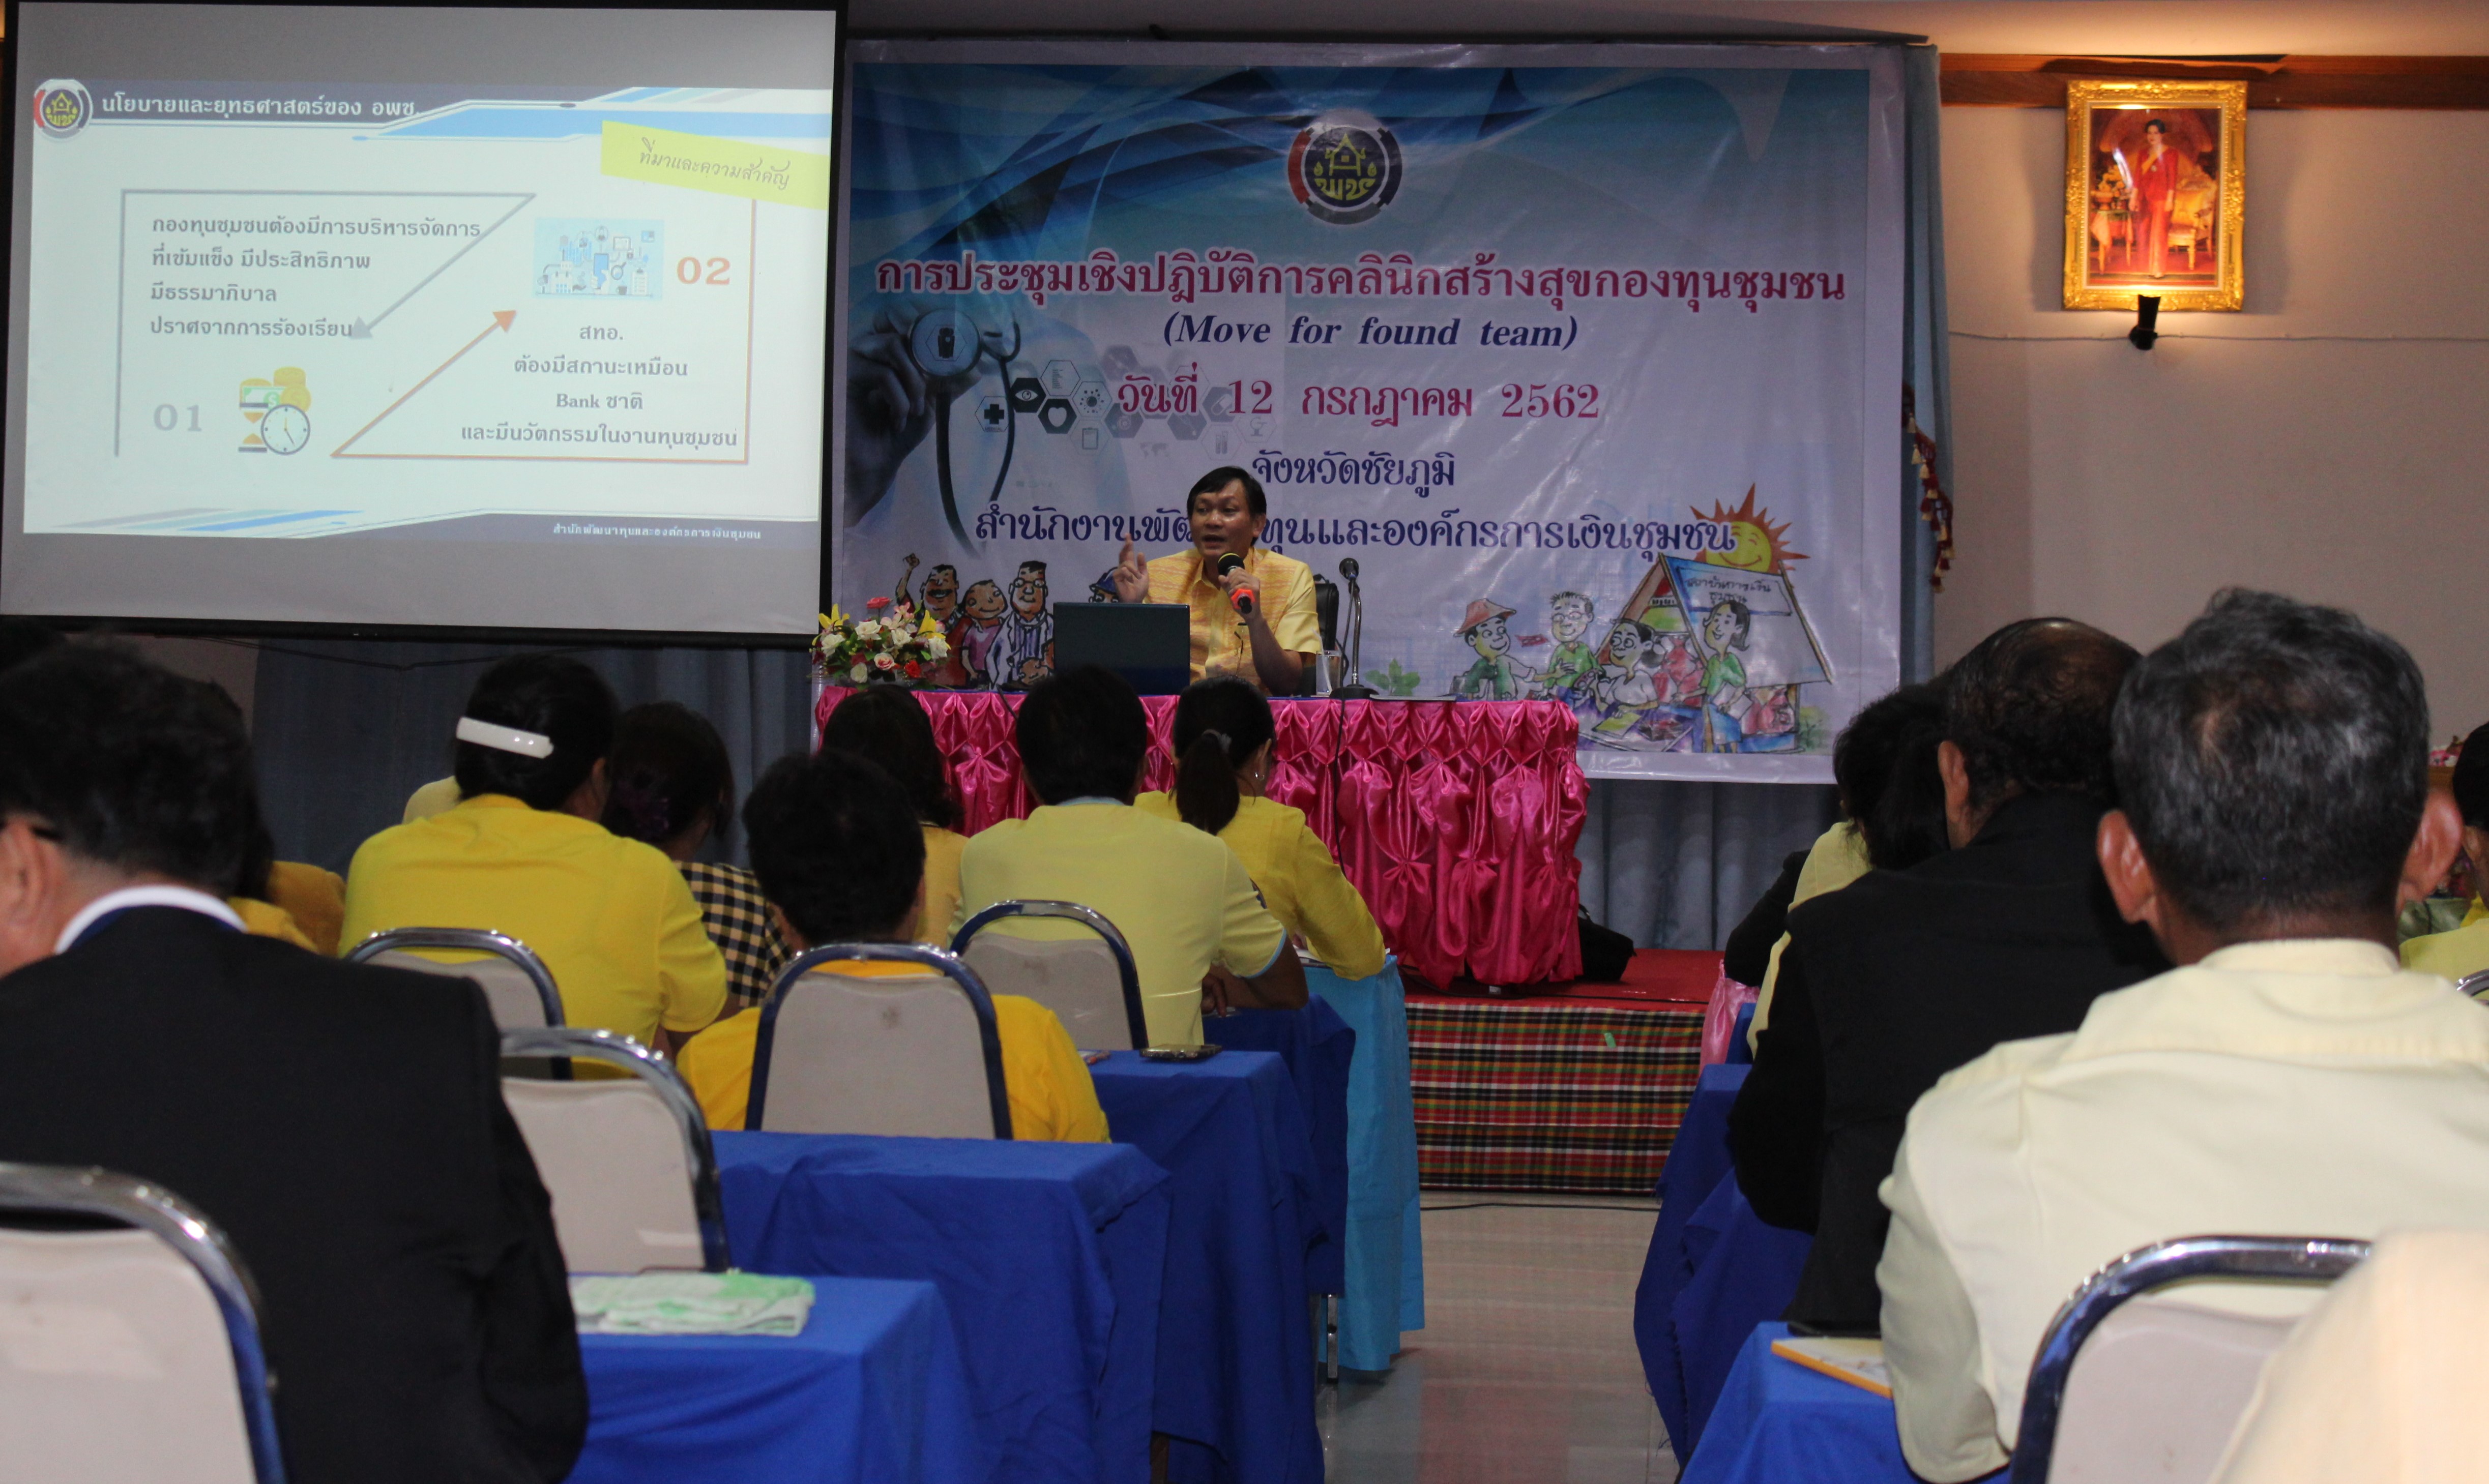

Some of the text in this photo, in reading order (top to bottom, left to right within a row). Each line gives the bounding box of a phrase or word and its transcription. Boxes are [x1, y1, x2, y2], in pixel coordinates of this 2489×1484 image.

[102, 91, 362, 119] นโยบายและยุทธศาสตร์ของ
[152, 216, 481, 239] กองทุนชุมชนต้องมีการบริหารจัดการ
[152, 243, 371, 270] ที่เข้มแข็ง มีประสิทธิภาพ
[676, 256, 731, 286] 02
[877, 250, 1845, 313] การประชุมเชิงปฏิบัติการคลินิกสร้างสุขกองทุนชุมชน
[151, 281, 277, 303] มีธรรมาภิบาล
[151, 316, 352, 338] ปราศจากการร้องเรียน
[579, 325, 624, 341] สทอ.
[1164, 312, 1578, 351] (Move for found team)
[514, 354, 689, 377] ต้องมีสถานะเหมือน
[556, 392, 644, 410] Bank ชาติ
[1118, 362, 1600, 427] วันที่ 12 กรกฎาคม 2562
[153, 404, 203, 432] 01
[461, 422, 738, 451] และมีนวัตกรรมในงานทุนชุมชน
[1252, 450, 1455, 498] จังหวัดชัยภูมิ
